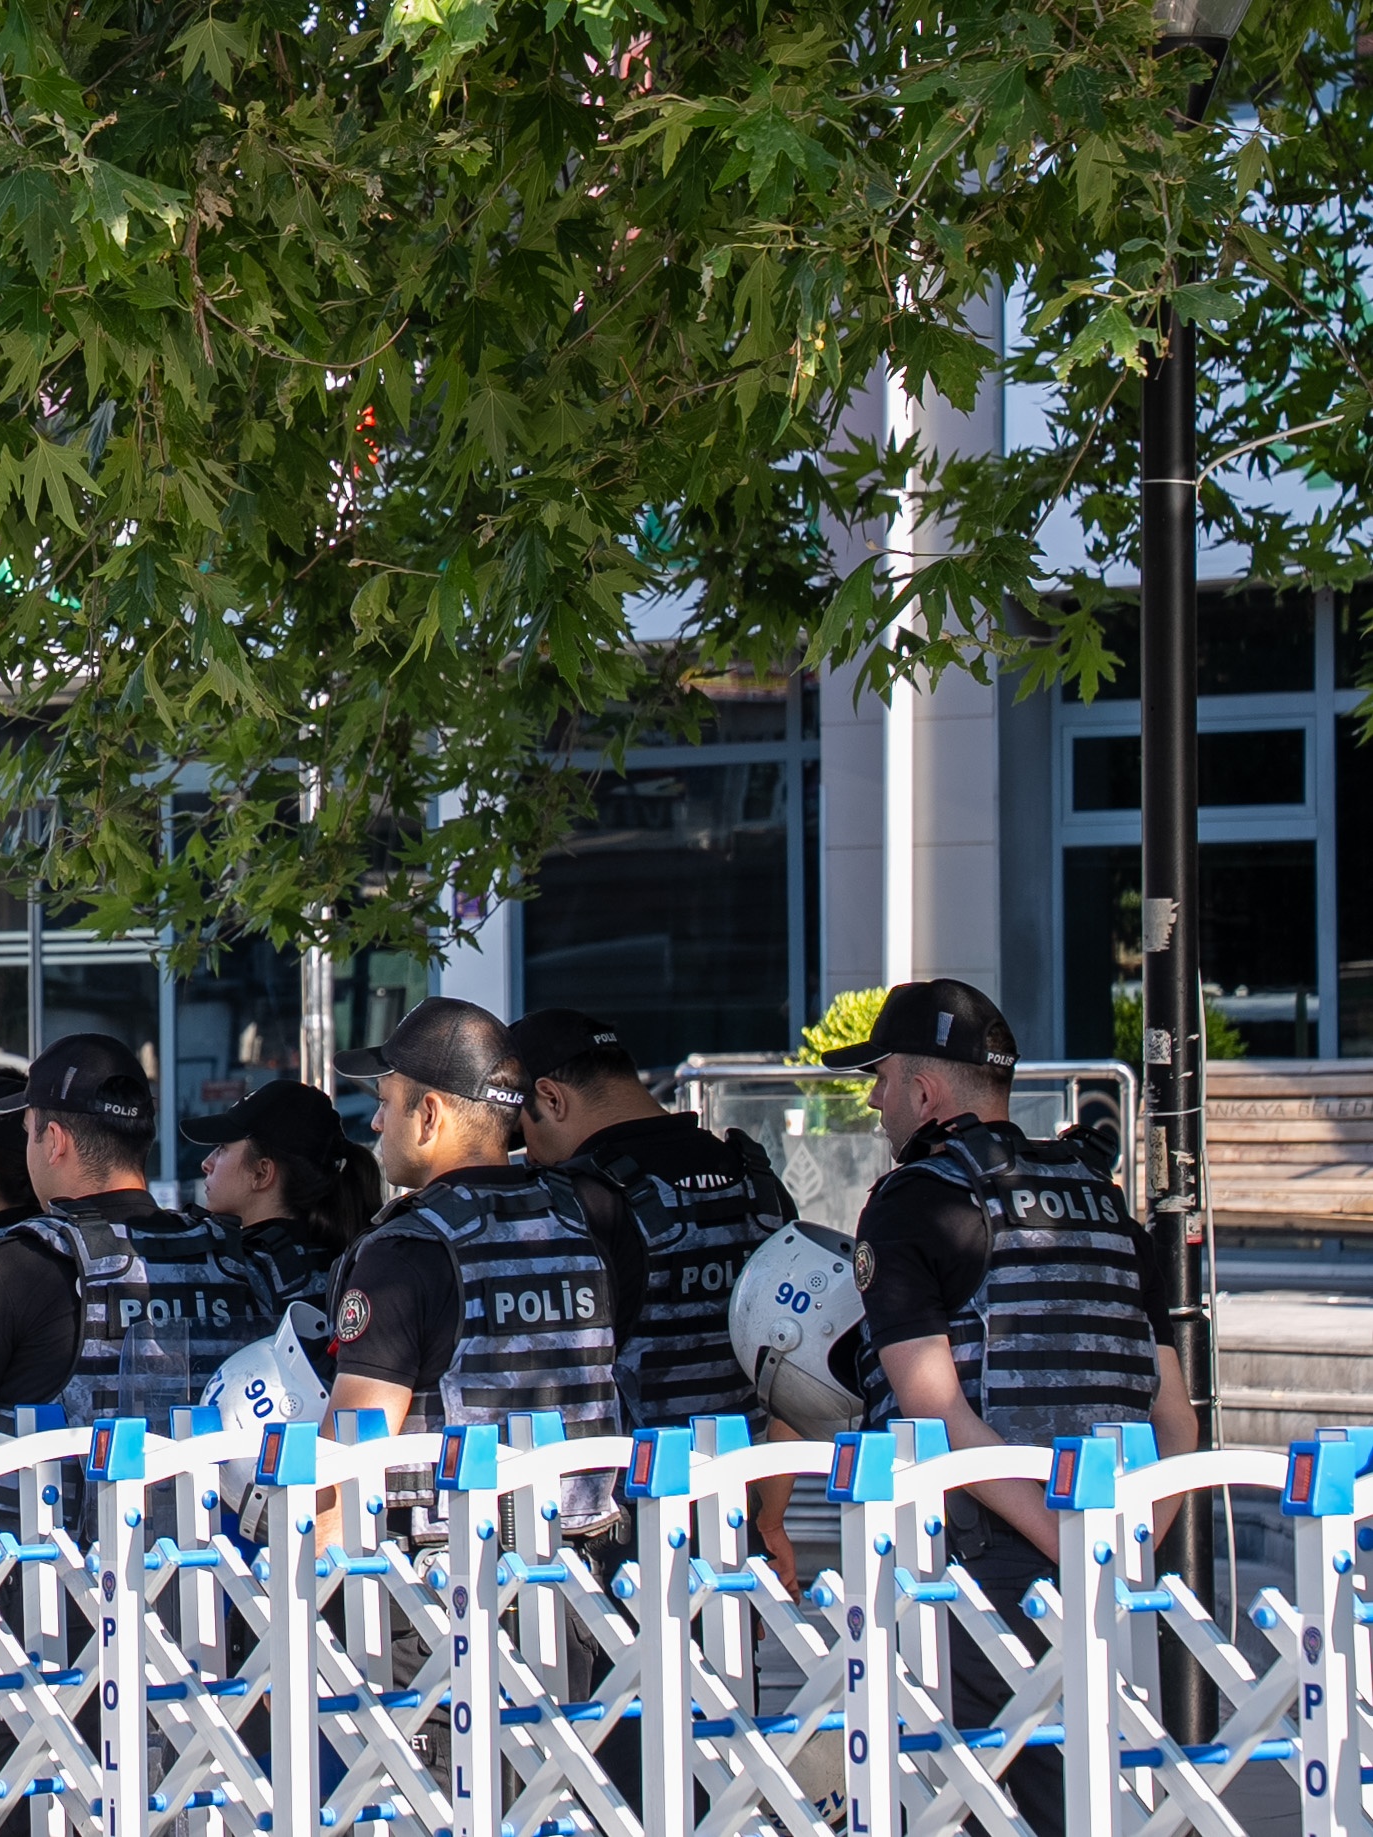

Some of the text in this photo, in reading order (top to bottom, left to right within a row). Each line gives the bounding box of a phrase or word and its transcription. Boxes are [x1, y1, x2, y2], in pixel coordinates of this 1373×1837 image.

[1011, 1186, 1120, 1224] POLİS
[495, 1280, 596, 1324] POLİS
[775, 1281, 811, 1314] 90
[245, 1378, 274, 1419] 90
[454, 1634, 472, 1837] POL
